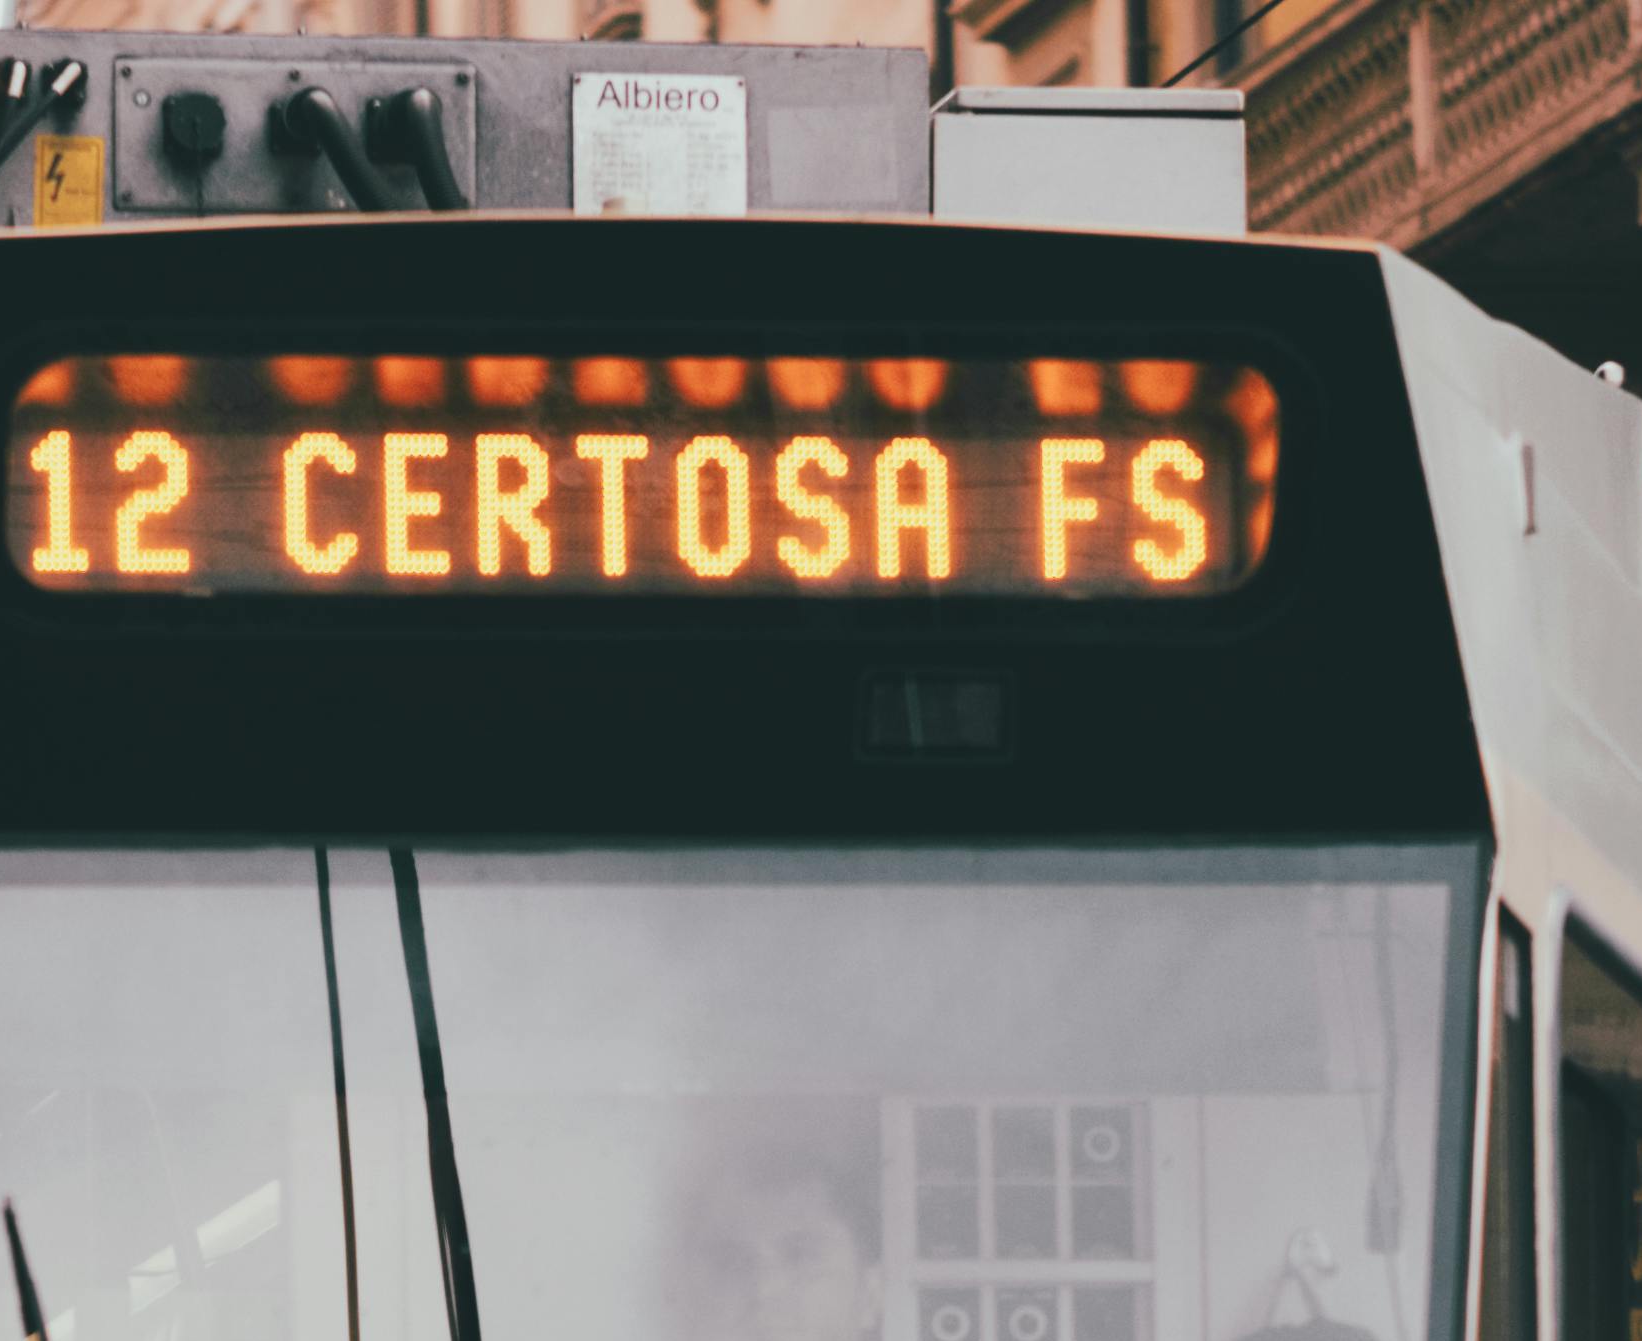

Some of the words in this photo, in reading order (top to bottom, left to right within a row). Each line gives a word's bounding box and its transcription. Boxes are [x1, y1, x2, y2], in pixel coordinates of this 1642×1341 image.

[597, 79, 719, 112] Albiero
[29, 430, 191, 574] 12
[282, 432, 952, 577] CERTOSA
[1039, 438, 1207, 580] FS
